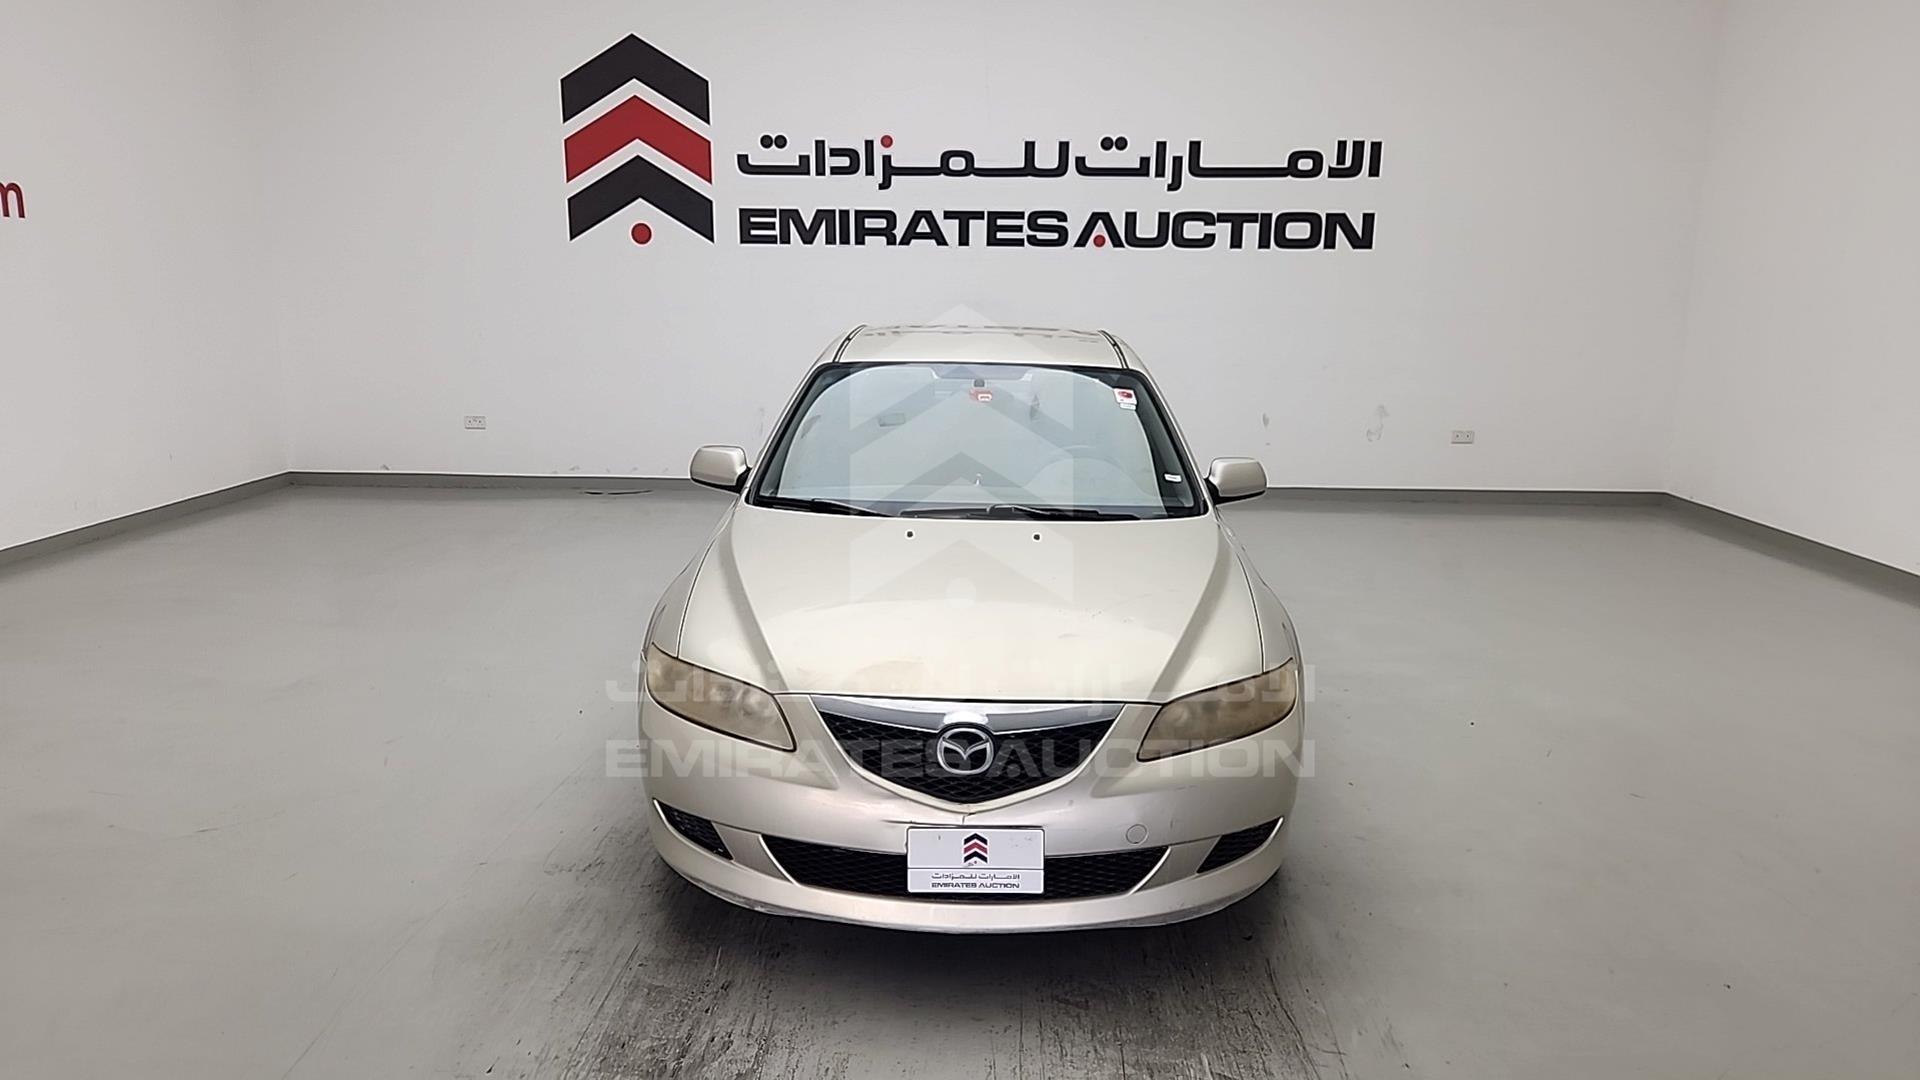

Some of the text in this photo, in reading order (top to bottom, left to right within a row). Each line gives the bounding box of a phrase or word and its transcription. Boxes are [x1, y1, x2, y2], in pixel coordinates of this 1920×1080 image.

[736, 134, 1383, 192] الامارات للمزادات
[738, 207, 1376, 250] EMIRATES AUCTION
